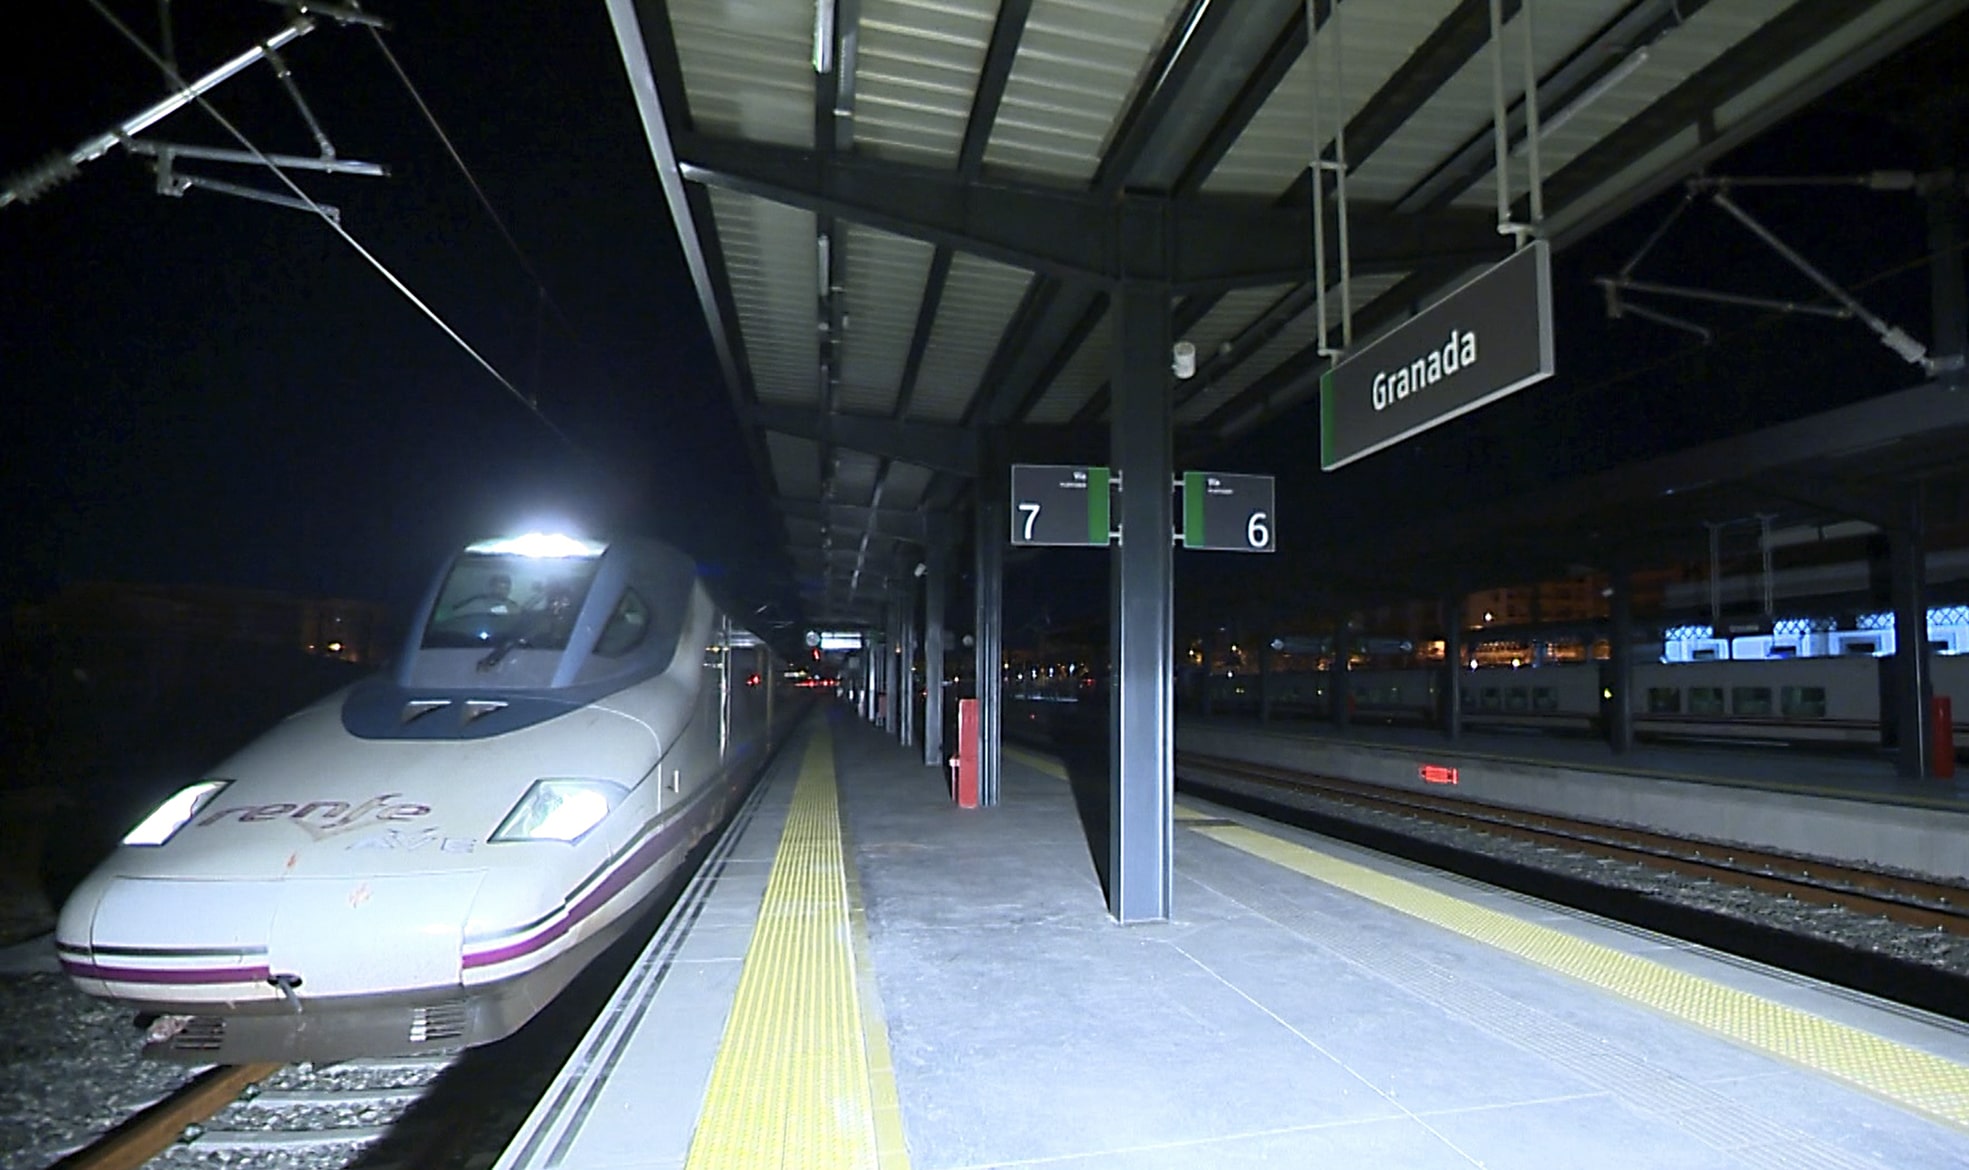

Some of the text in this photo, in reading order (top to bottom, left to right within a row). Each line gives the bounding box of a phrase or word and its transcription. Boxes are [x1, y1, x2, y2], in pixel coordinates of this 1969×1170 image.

[1372, 329, 1477, 411] Granada
[1018, 504, 1041, 540] 7
[1247, 512, 1269, 547] 6
[199, 792, 431, 830] renfe
